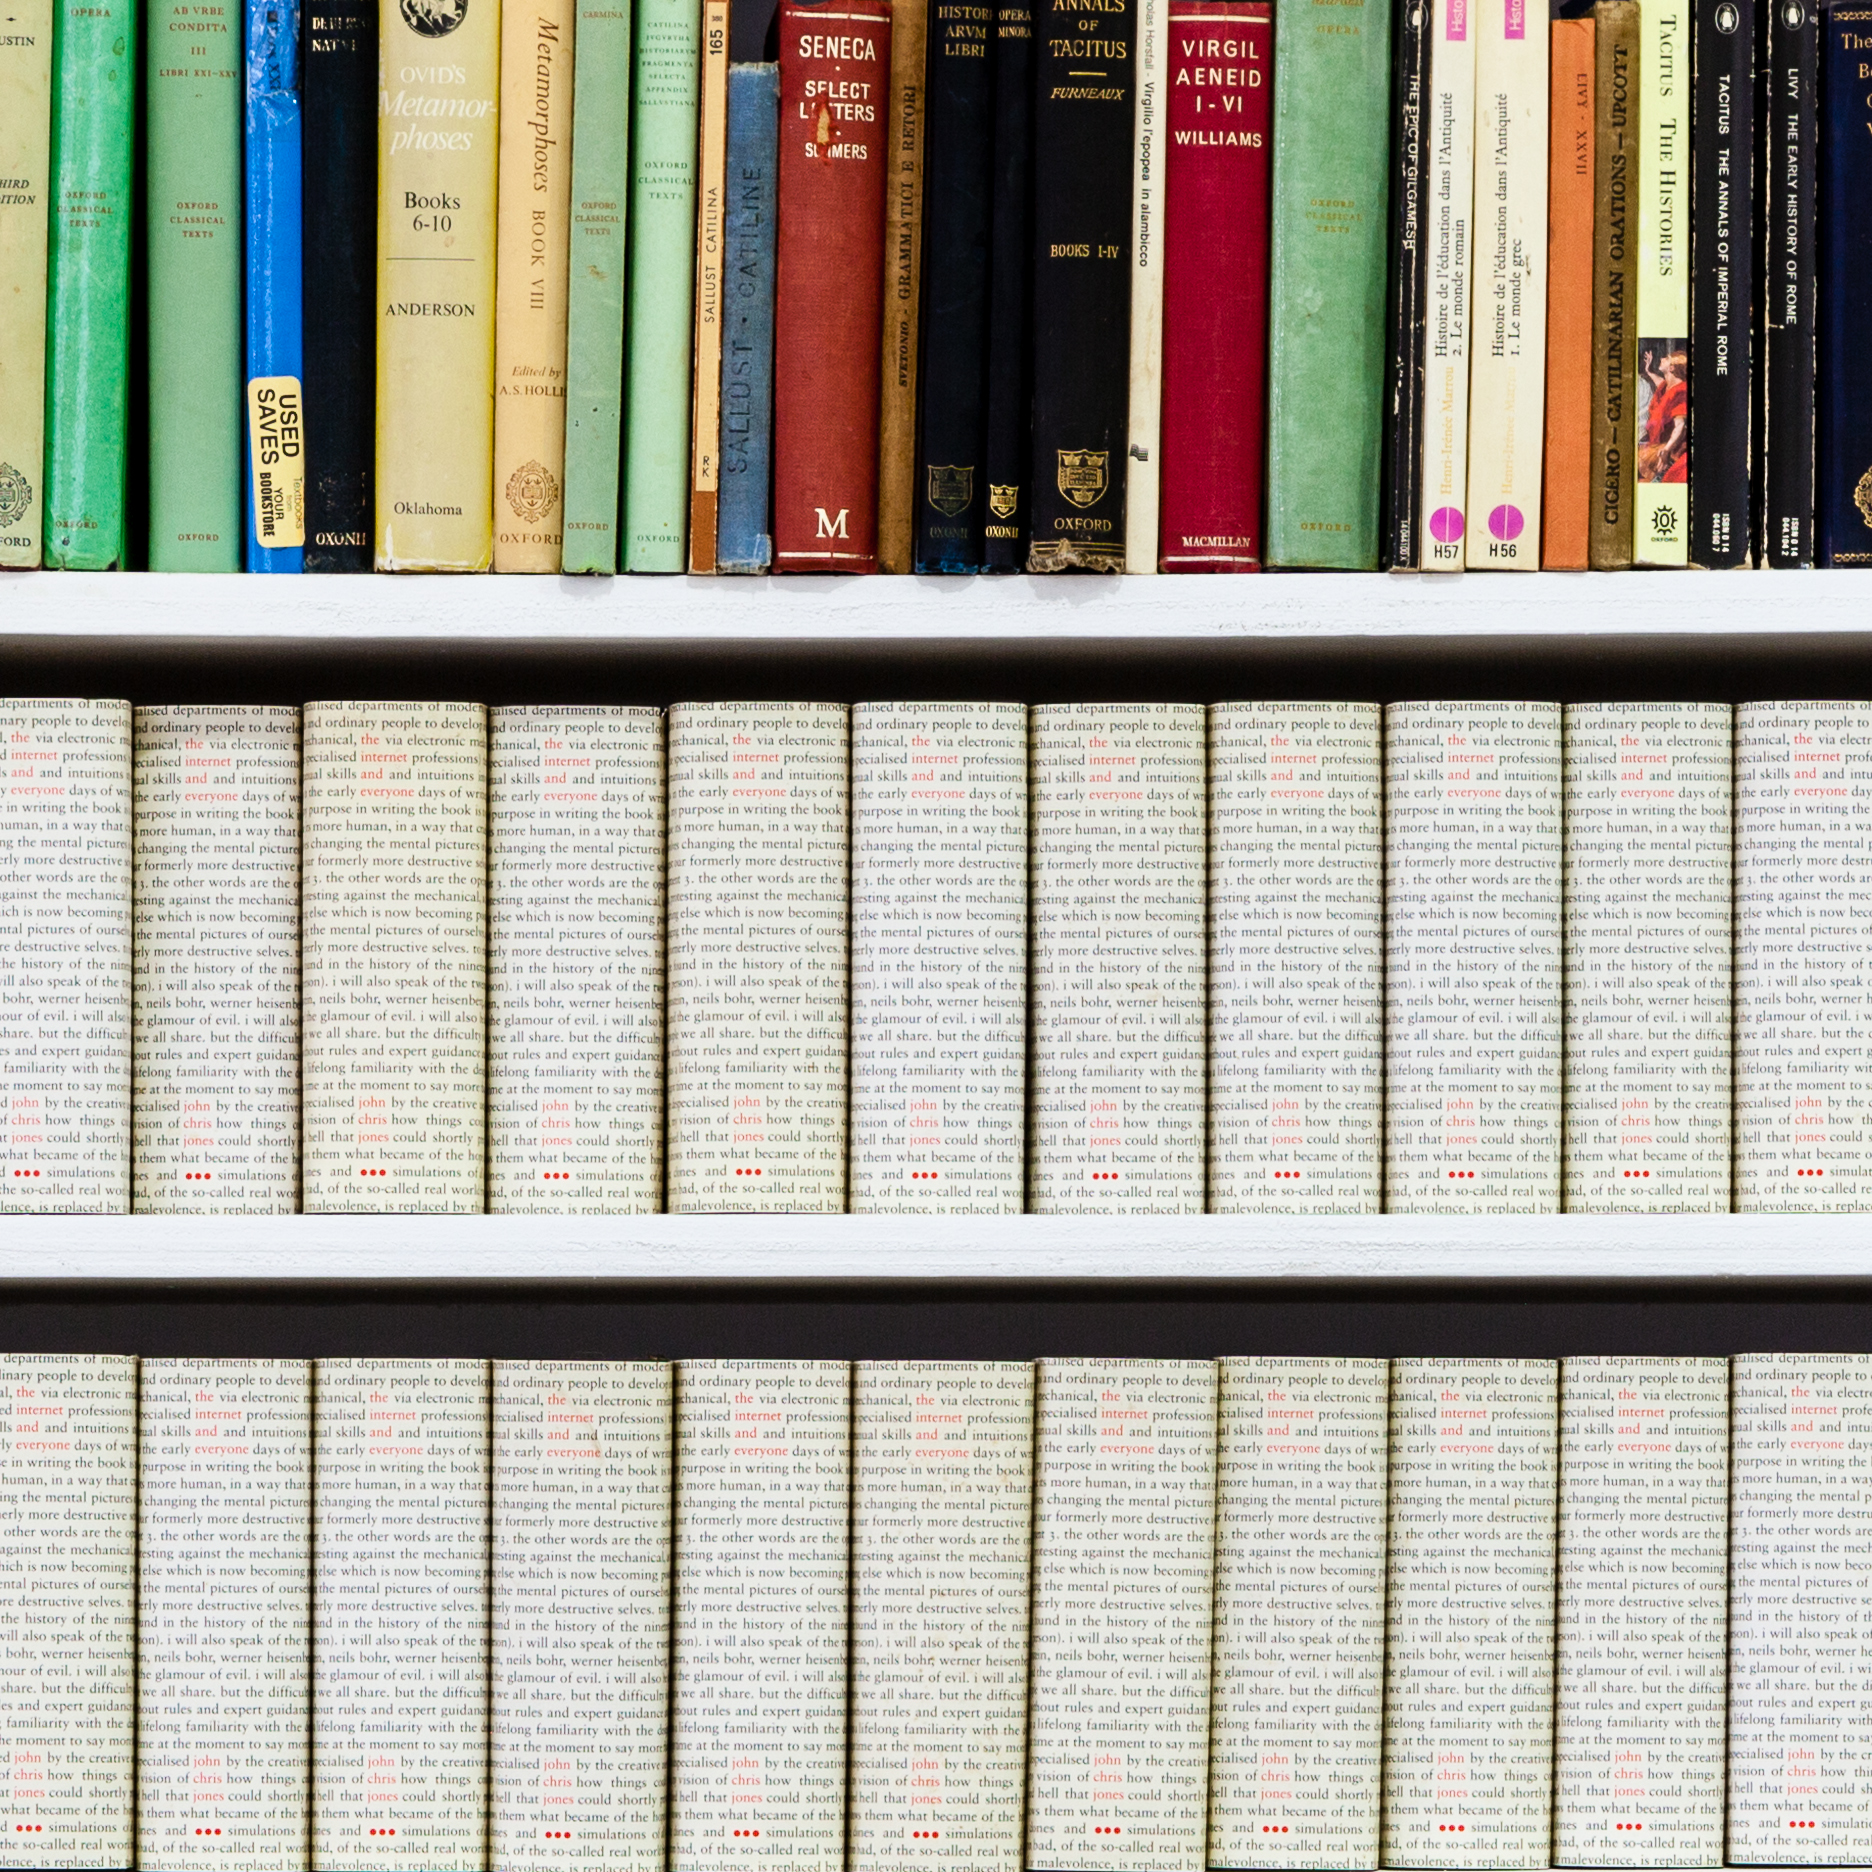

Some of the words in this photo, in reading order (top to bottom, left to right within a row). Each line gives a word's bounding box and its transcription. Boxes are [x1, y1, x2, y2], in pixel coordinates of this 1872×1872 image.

[799, 35, 875, 60] SENECA
[1049, 40, 1126, 58] TACITUS
[1183, 40, 1258, 58] VIRGIL
[528, 17, 559, 192] Metamorphoses
[1175, 131, 1261, 147] WILLIAMS
[405, 192, 460, 209] Books
[532, 211, 545, 265] BOOK
[531, 279, 544, 309] VIII
[385, 303, 475, 317] ANDERSON
[258, 389, 279, 464] SAVES
[279, 395, 299, 457] USED
[260, 472, 275, 536] BOOKSTORE
[394, 502, 462, 515] Oklahoma
[815, 508, 849, 538] M
[1182, 537, 1250, 547] MACMILLAN
[1435, 545, 1458, 558] H57
[594, 1395, 652, 1406] electronic
[548, 1414, 593, 1422] internet
